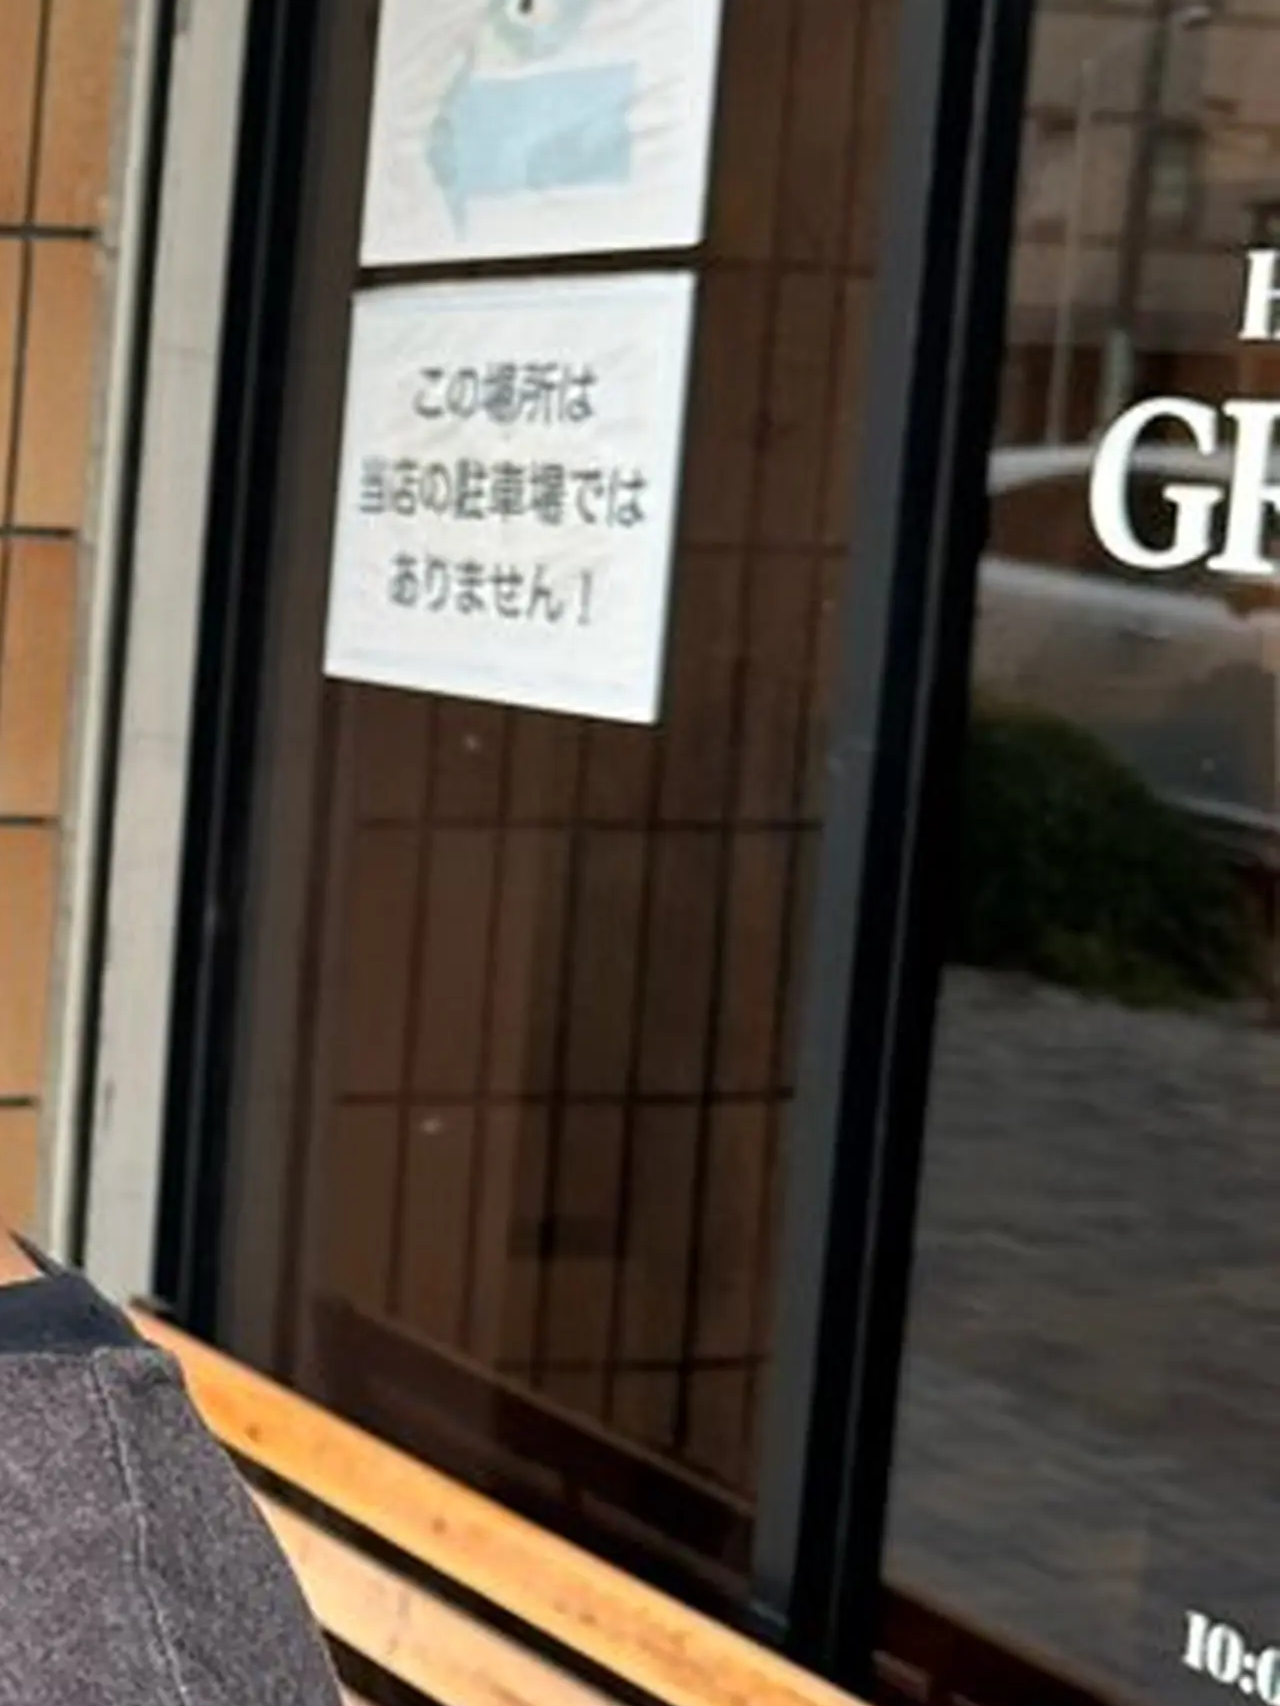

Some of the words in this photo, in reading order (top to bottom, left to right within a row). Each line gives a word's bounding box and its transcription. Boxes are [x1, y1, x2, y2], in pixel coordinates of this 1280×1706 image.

[413, 361, 599, 426] この場所は
[359, 455, 647, 529] 当店の駐車場では
[389, 551, 593, 625] ありません！
